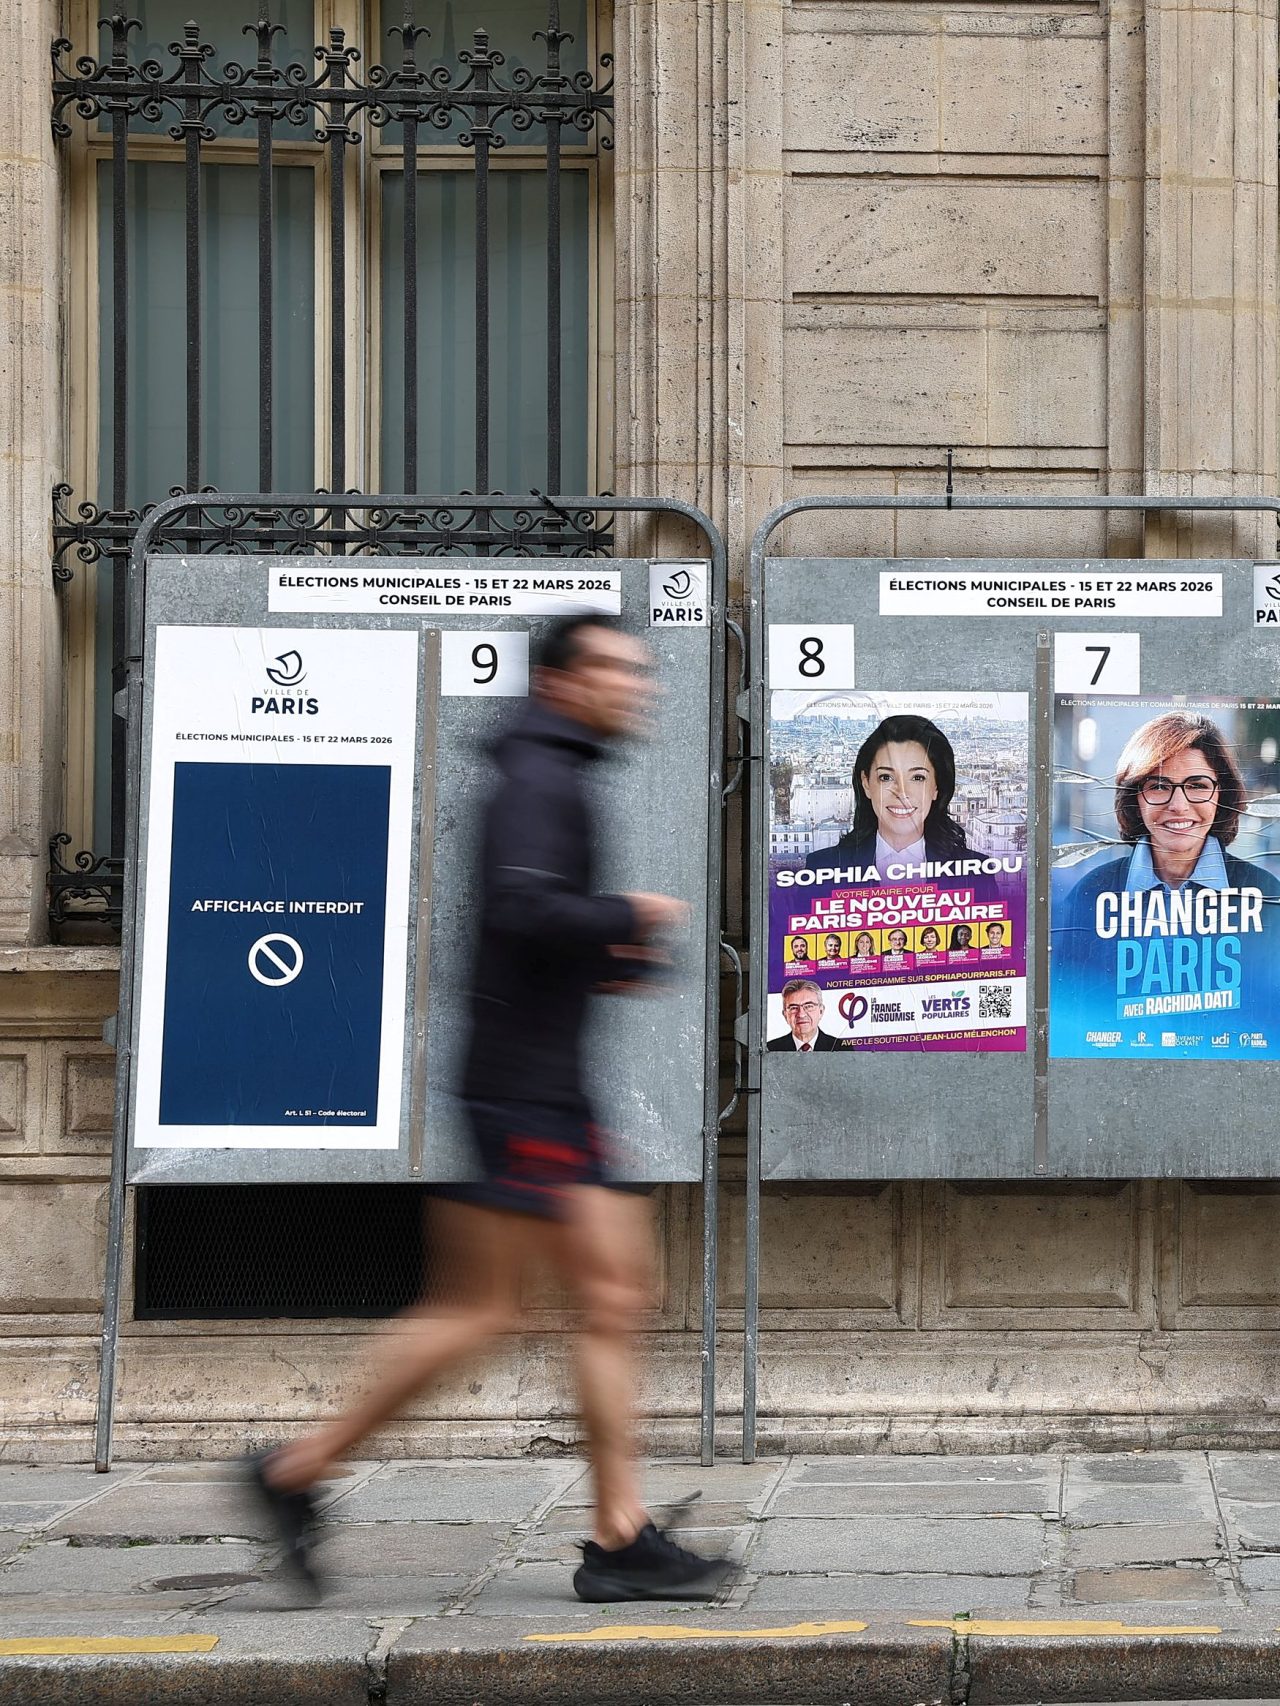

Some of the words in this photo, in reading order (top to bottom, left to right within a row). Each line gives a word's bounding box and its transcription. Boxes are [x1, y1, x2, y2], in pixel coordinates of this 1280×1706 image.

[279, 574, 359, 588] ÉLECTIONS
[363, 577, 461, 589] MUNICIPALES
[474, 578, 488, 589] 15
[491, 579, 509, 590] ET
[512, 579, 529, 590] 22
[532, 579, 574, 590] MARS
[577, 579, 611, 590] 2026
[889, 578, 967, 591] ÉLECTIONS
[970, 580, 1067, 592] MUNICIPALES
[1078, 581, 1092, 592] 15
[1096, 581, 1113, 592] ET
[1116, 581, 1133, 592] 22
[1136, 581, 1177, 592] MARS
[1180, 582, 1213, 592] 2026
[379, 594, 441, 605] CONSEIL
[445, 595, 465, 606] DE
[469, 595, 512, 607] PARIS
[986, 597, 1047, 608] CONSEIL
[1051, 598, 1071, 608] DE
[1074, 598, 1116, 608] PARIS
[653, 607, 703, 622] PARIS
[471, 643, 498, 684] 9
[798, 637, 825, 677] 8
[1085, 646, 1111, 685] 7
[251, 697, 319, 715] PARIS
[175, 731, 229, 741] ÉLECTIONS
[230, 734, 295, 743] MUNICIPALES
[302, 735, 312, 743] 15
[314, 735, 326, 743] ET
[328, 735, 339, 743] 22
[340, 736, 368, 744] MARS
[370, 736, 393, 744] 2026
[776, 865, 881, 887] SOPHIA
[886, 856, 1023, 881] CHIKIROU
[835, 889, 869, 899] VOTRE
[871, 887, 903, 897] MAIRE
[905, 885, 934, 895] POUR
[191, 899, 285, 913] AFFICHAGE
[289, 901, 364, 914] INTERDIT
[815, 899, 845, 915] LE
[849, 891, 971, 913] NOUVEAU
[790, 913, 863, 931] PARIS
[867, 904, 1004, 927] POPULAIRE
[1095, 886, 1264, 939] CHANGER
[1116, 935, 1242, 995] PARIS
[826, 979, 854, 988] NOTRE
[854, 976, 906, 986] PROGRAMME
[907, 975, 924, 983] SUR
[924, 969, 1017, 982] SOPHIAPOURPARIS.FR
[871, 1002, 901, 1013] FRANCE
[922, 997, 971, 1012] VERTS
[1123, 1003, 1144, 1018] AVEC
[1145, 991, 1203, 1015] RACHIDA
[1204, 989, 1233, 1008] DATI
[921, 1010, 970, 1020] POPULAIRES
[841, 1038, 863, 1046] AVEC
[873, 1036, 909, 1044] SOUTIEN
[920, 1032, 963, 1041] JEAN-LUC
[963, 1028, 1017, 1039] MÉLENCHON
[1211, 1032, 1230, 1044] udi
